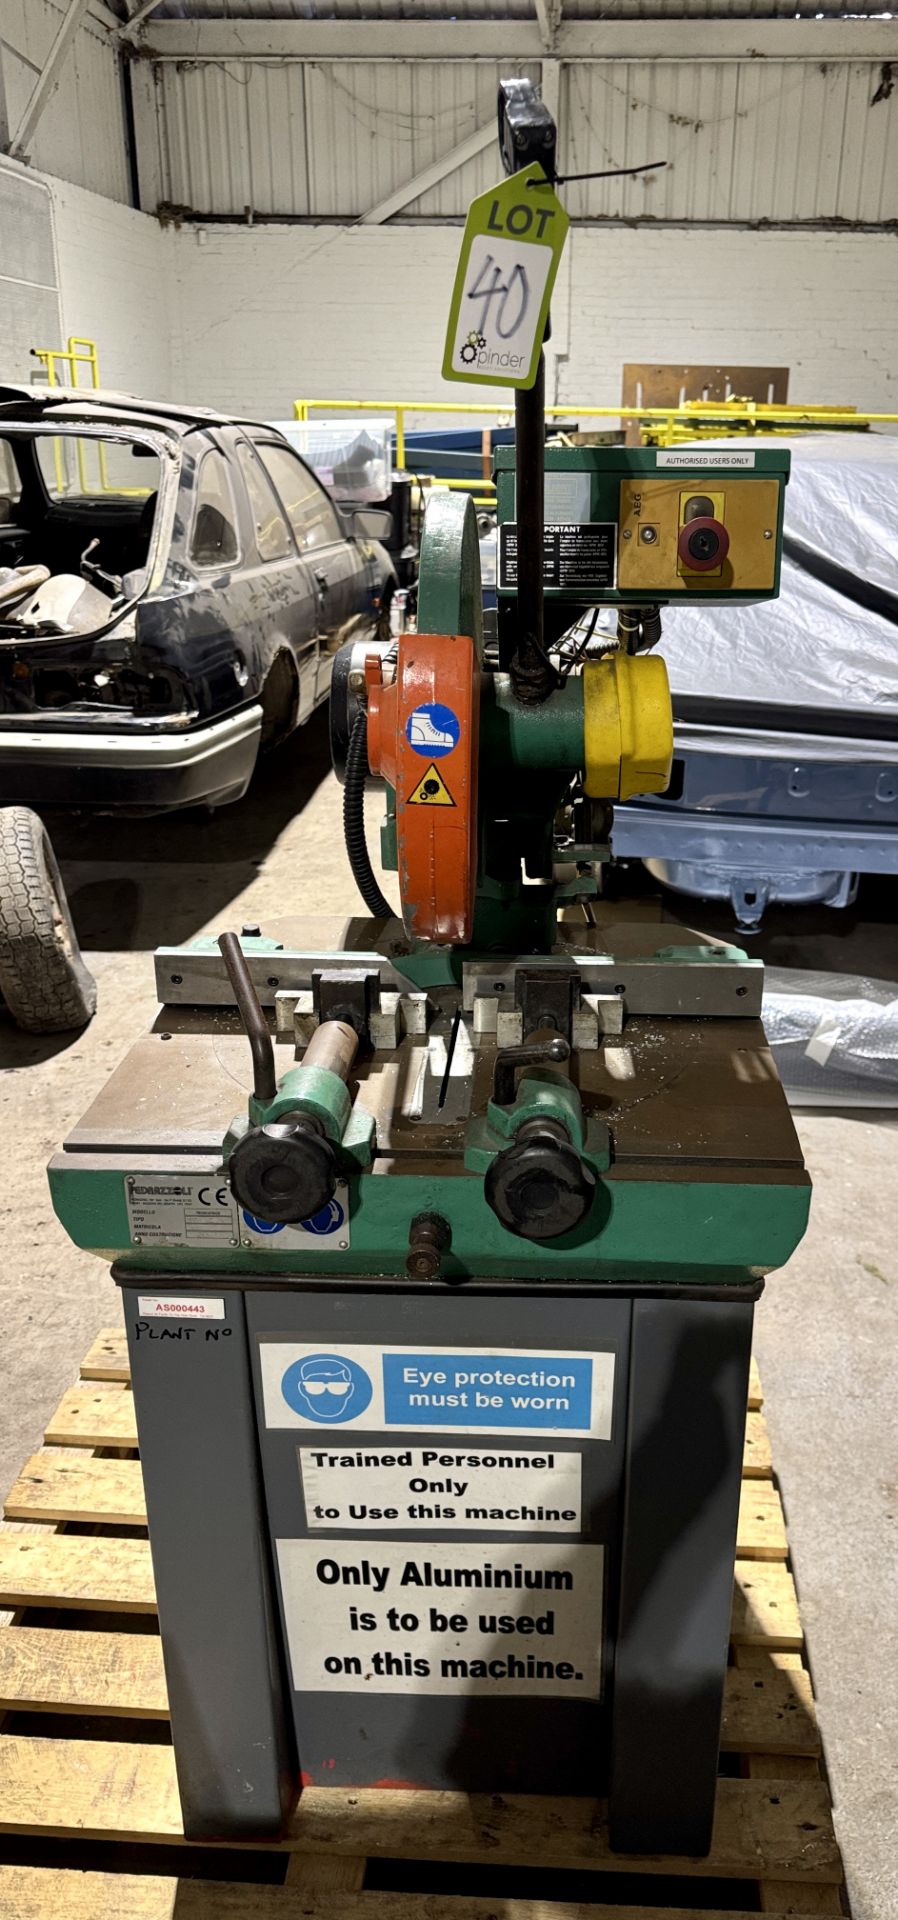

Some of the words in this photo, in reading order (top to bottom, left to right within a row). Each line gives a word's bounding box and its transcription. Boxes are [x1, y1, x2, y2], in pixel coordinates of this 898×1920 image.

[487, 200, 555, 239] LOT
[467, 254, 530, 340] 40
[477, 348, 526, 368] pinder
[666, 457, 708, 465] AUTHORISED
[709, 457, 730, 465] USERS
[731, 457, 749, 465] ONLY
[632, 493, 642, 517] AEG
[156, 1303, 205, 1313] AS000443
[135, 1321, 196, 1340] PLANT
[403, 1367, 447, 1389] Eye
[455, 1370, 576, 1390] protection
[408, 1392, 468, 1408] must
[476, 1393, 503, 1408] be
[511, 1395, 570, 1410] worn
[311, 1452, 412, 1467] Trained
[422, 1453, 554, 1469] Personnel
[408, 1478, 468, 1496] Only
[313, 1506, 340, 1519] to
[349, 1505, 398, 1519] Use
[407, 1504, 456, 1519] this
[465, 1506, 577, 1521] machine
[316, 1559, 390, 1591] Only
[400, 1561, 573, 1590] Aluminium
[350, 1607, 377, 1631] is
[386, 1608, 419, 1632] to
[430, 1608, 468, 1633] be
[478, 1611, 554, 1635] used
[324, 1654, 361, 1675] on
[371, 1652, 430, 1677] this
[440, 1655, 583, 1680] machine.
